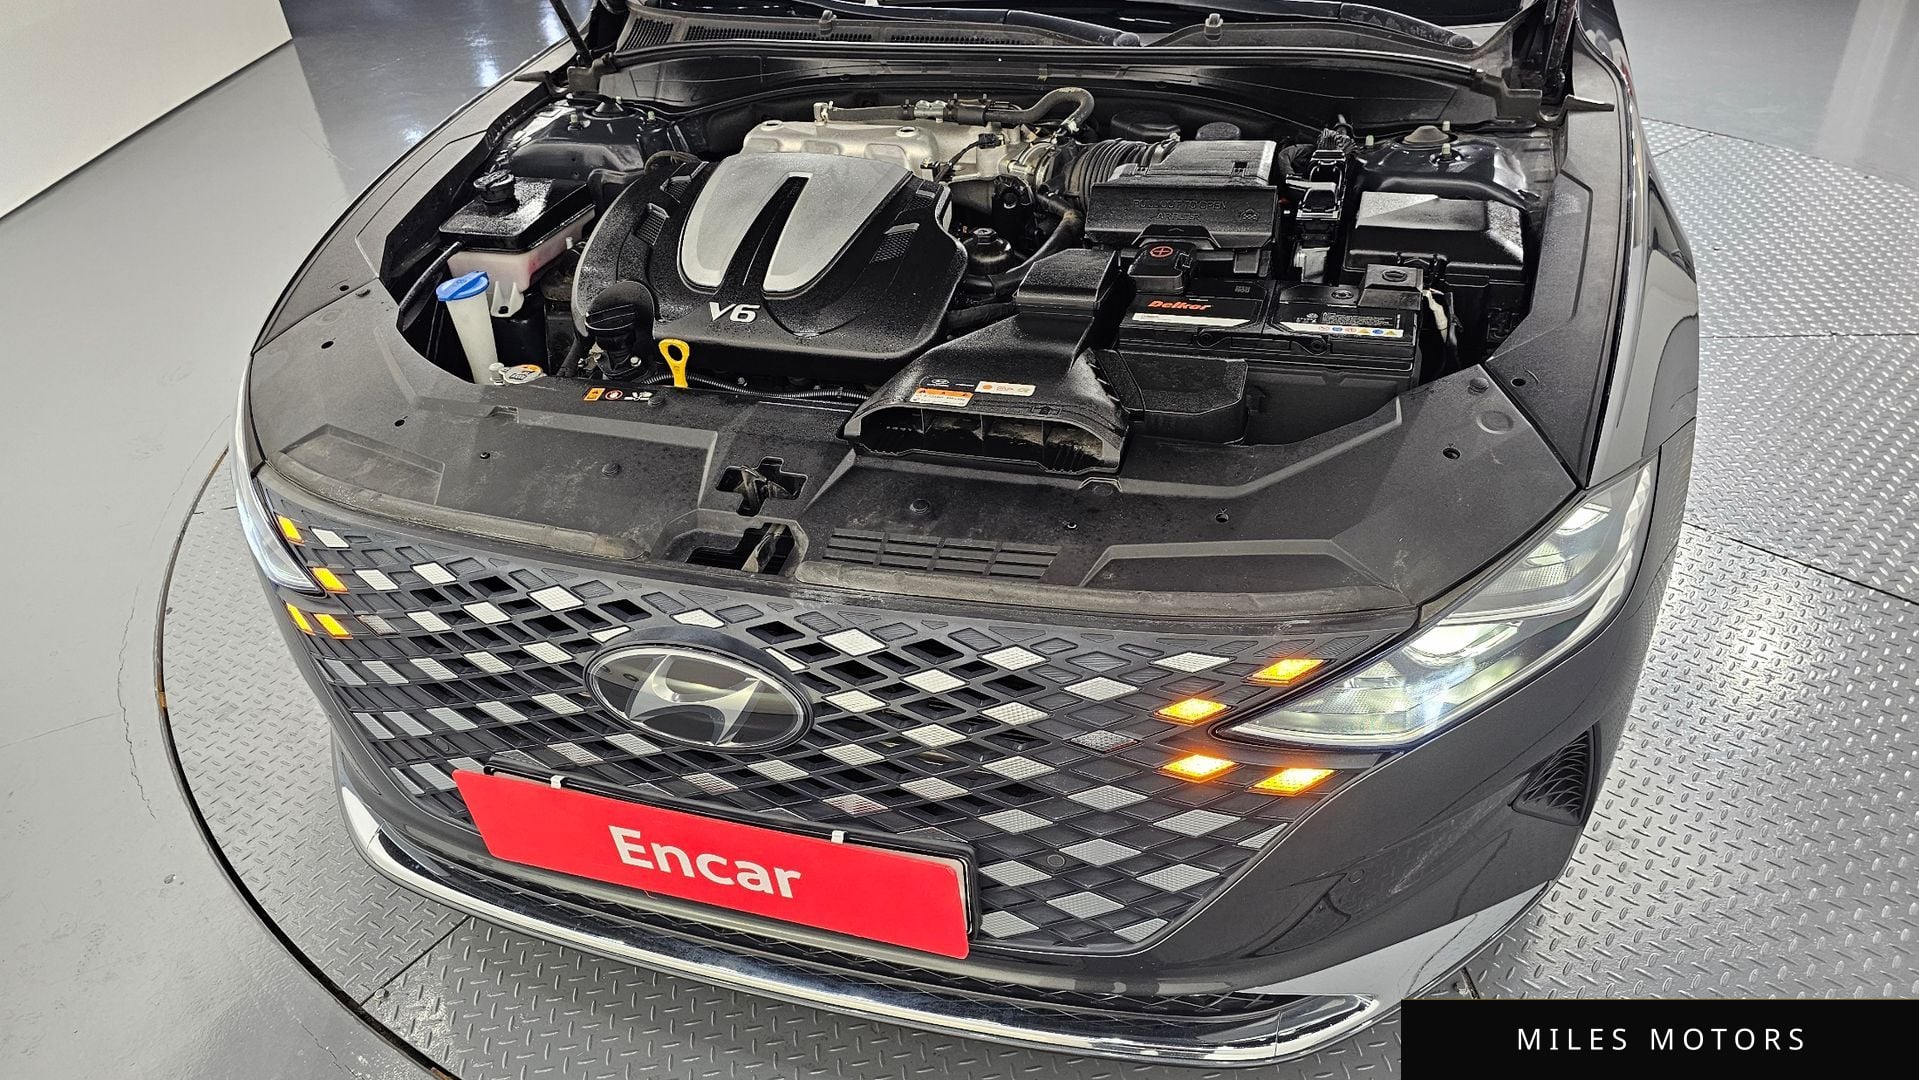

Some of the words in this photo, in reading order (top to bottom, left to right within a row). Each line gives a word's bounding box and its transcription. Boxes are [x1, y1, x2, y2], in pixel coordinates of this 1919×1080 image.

[1133, 199, 1159, 209] PULL
[1160, 199, 1182, 210] OUT
[1184, 199, 1197, 210] TO
[1199, 199, 1227, 211] OPEN
[709, 302, 761, 323] V6
[1147, 299, 1212, 311] Delkor
[608, 825, 801, 899] Encar
